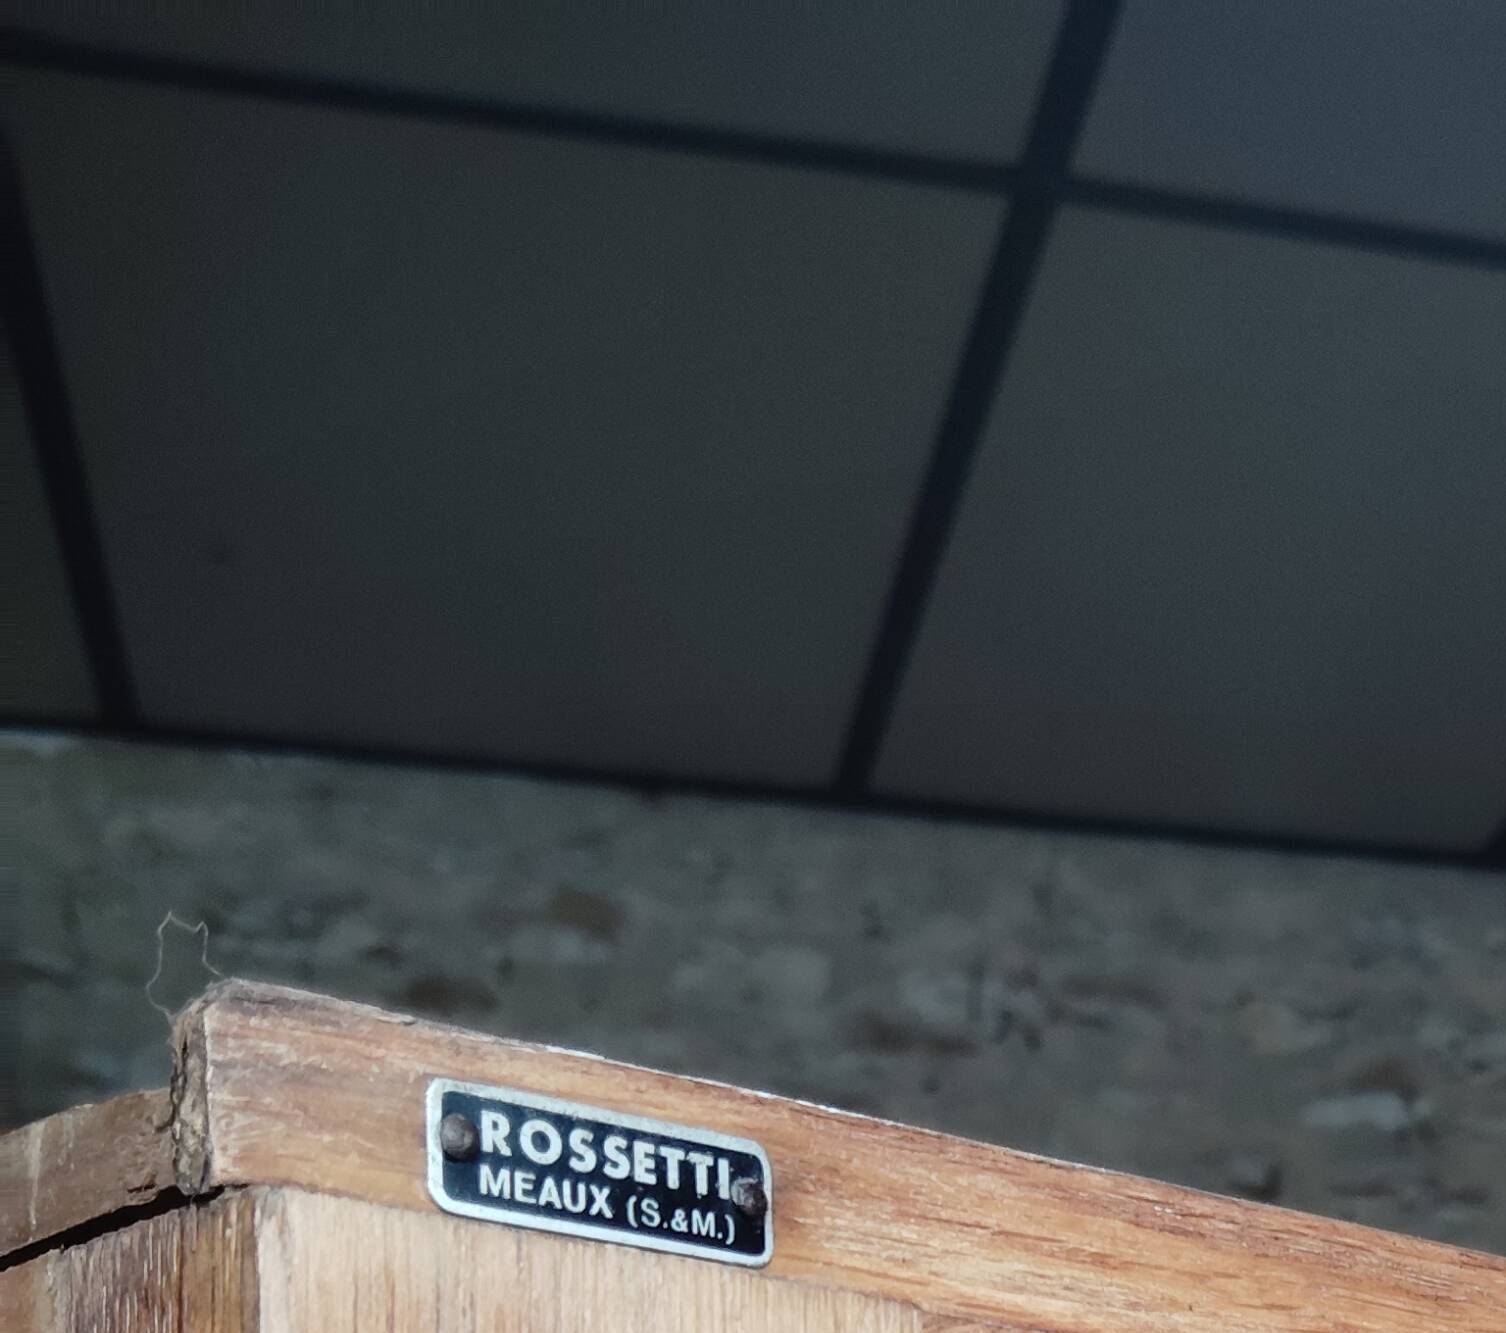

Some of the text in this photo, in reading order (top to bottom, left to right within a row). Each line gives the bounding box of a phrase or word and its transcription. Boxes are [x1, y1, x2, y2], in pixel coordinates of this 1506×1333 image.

[480, 1110, 731, 1200] ROSSETTI
[479, 1165, 735, 1245] MEAUX (S.&M.)
